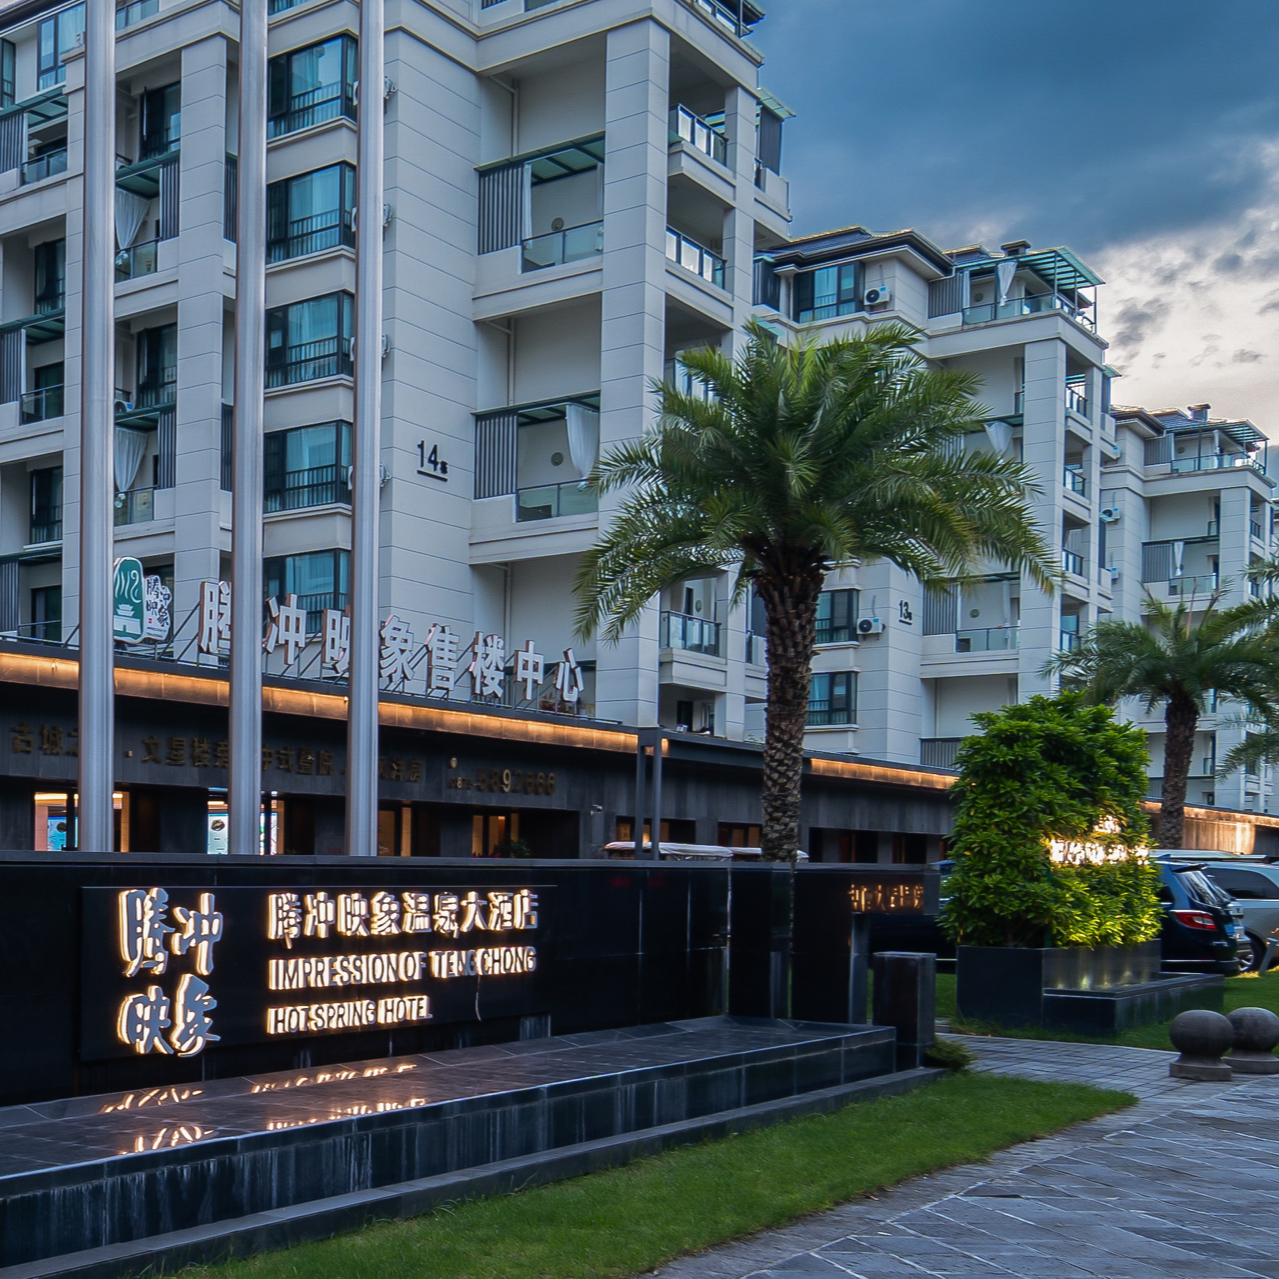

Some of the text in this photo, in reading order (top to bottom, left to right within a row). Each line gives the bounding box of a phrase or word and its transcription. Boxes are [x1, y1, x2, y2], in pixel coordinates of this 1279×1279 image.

[198, 581, 585, 703] 腾冲映象售楼中心
[119, 888, 223, 977] 腾冲
[268, 889, 538, 940] 腾冲映象温泉大酒店
[269, 953, 400, 990] IMPRESSION
[399, 951, 427, 982] OF
[476, 946, 537, 976] CHONG
[267, 995, 433, 1034] HOT SPRING HOTEL
